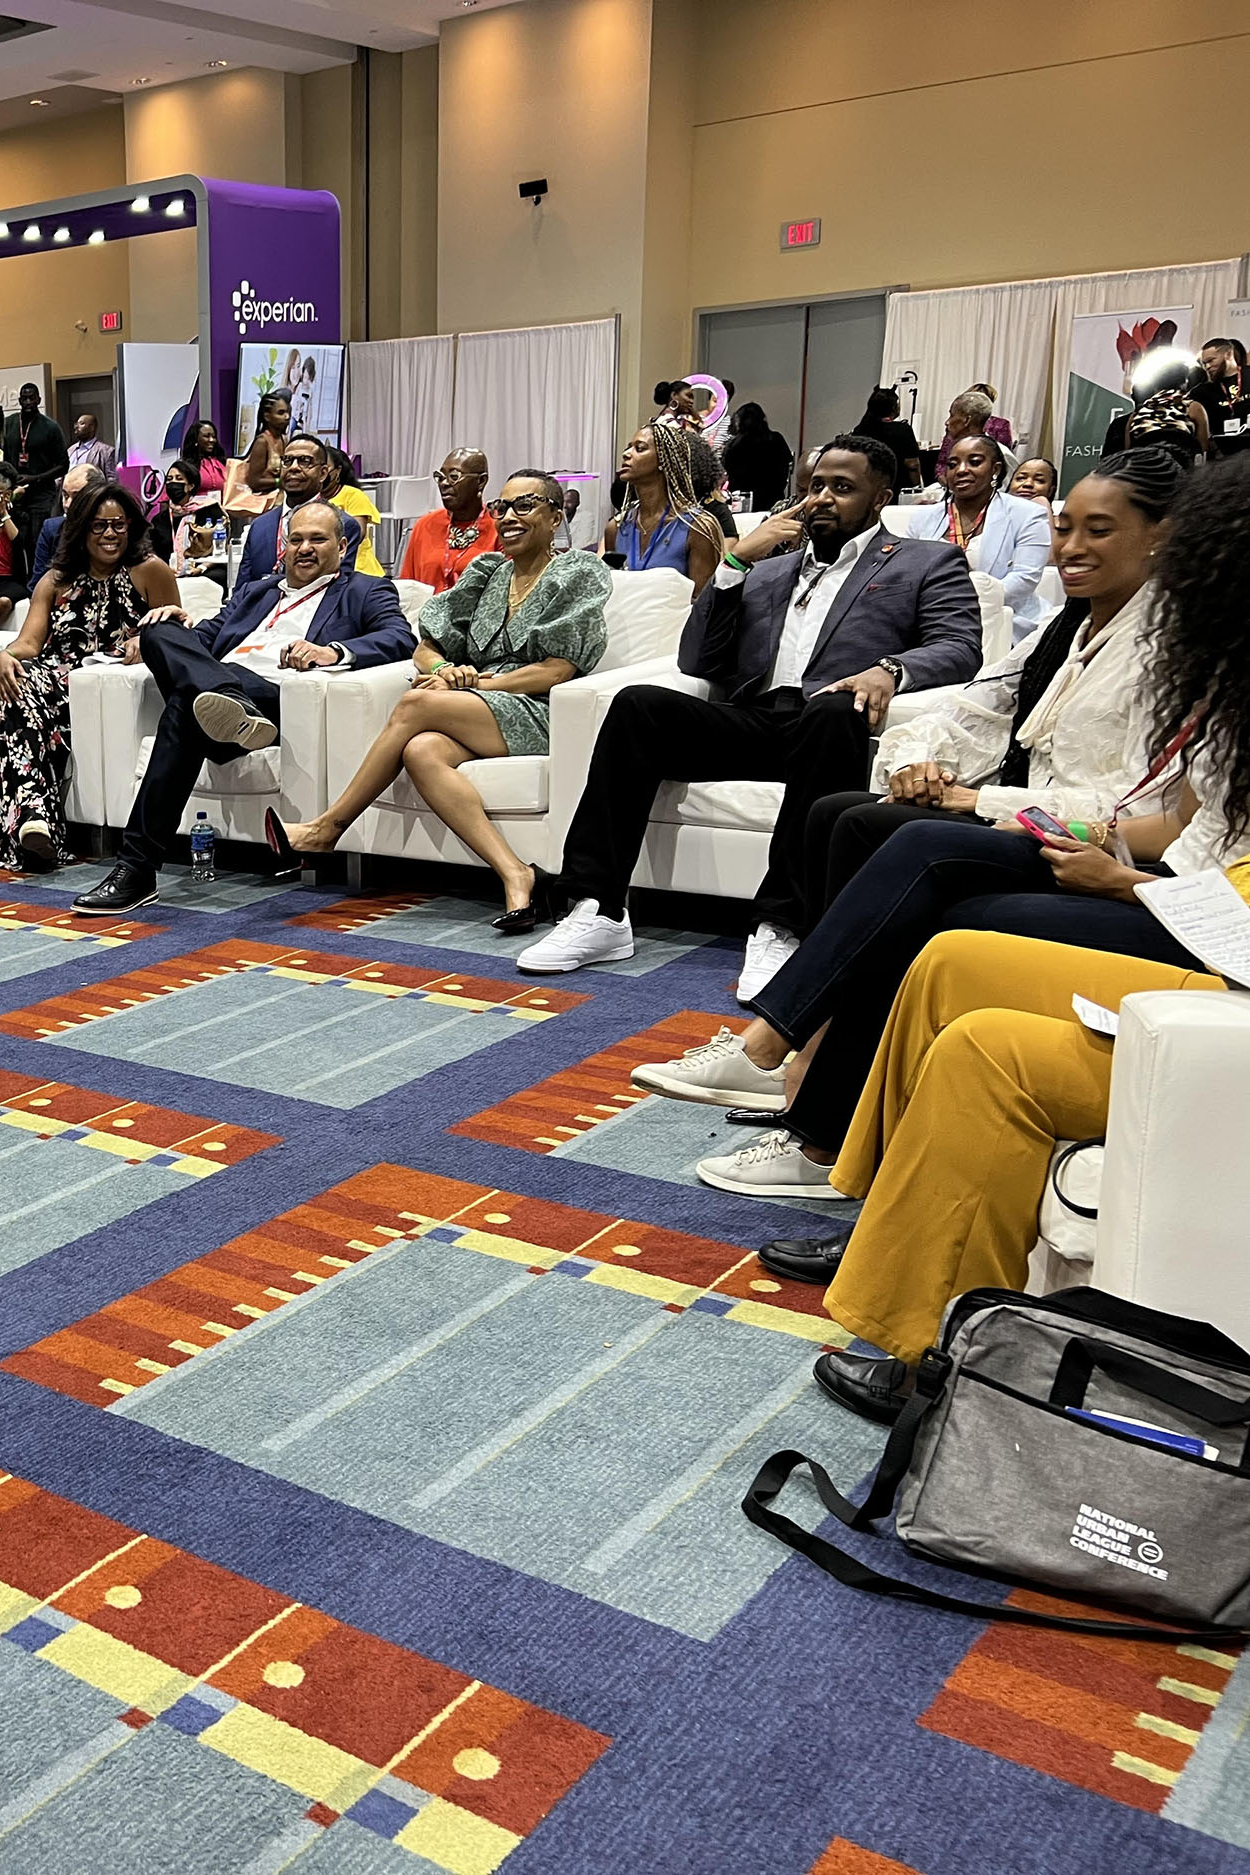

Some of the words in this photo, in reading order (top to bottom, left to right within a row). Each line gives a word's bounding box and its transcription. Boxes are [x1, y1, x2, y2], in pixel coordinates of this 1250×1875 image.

[787, 221, 815, 245] EXIT
[102, 312, 118, 329] EXIT
[1076, 1514, 1130, 1543] URBAN
[1079, 1503, 1158, 1542] NATIONAL
[1072, 1525, 1132, 1556] LEAGUE
[1069, 1536, 1169, 1581] CONFERENCE
